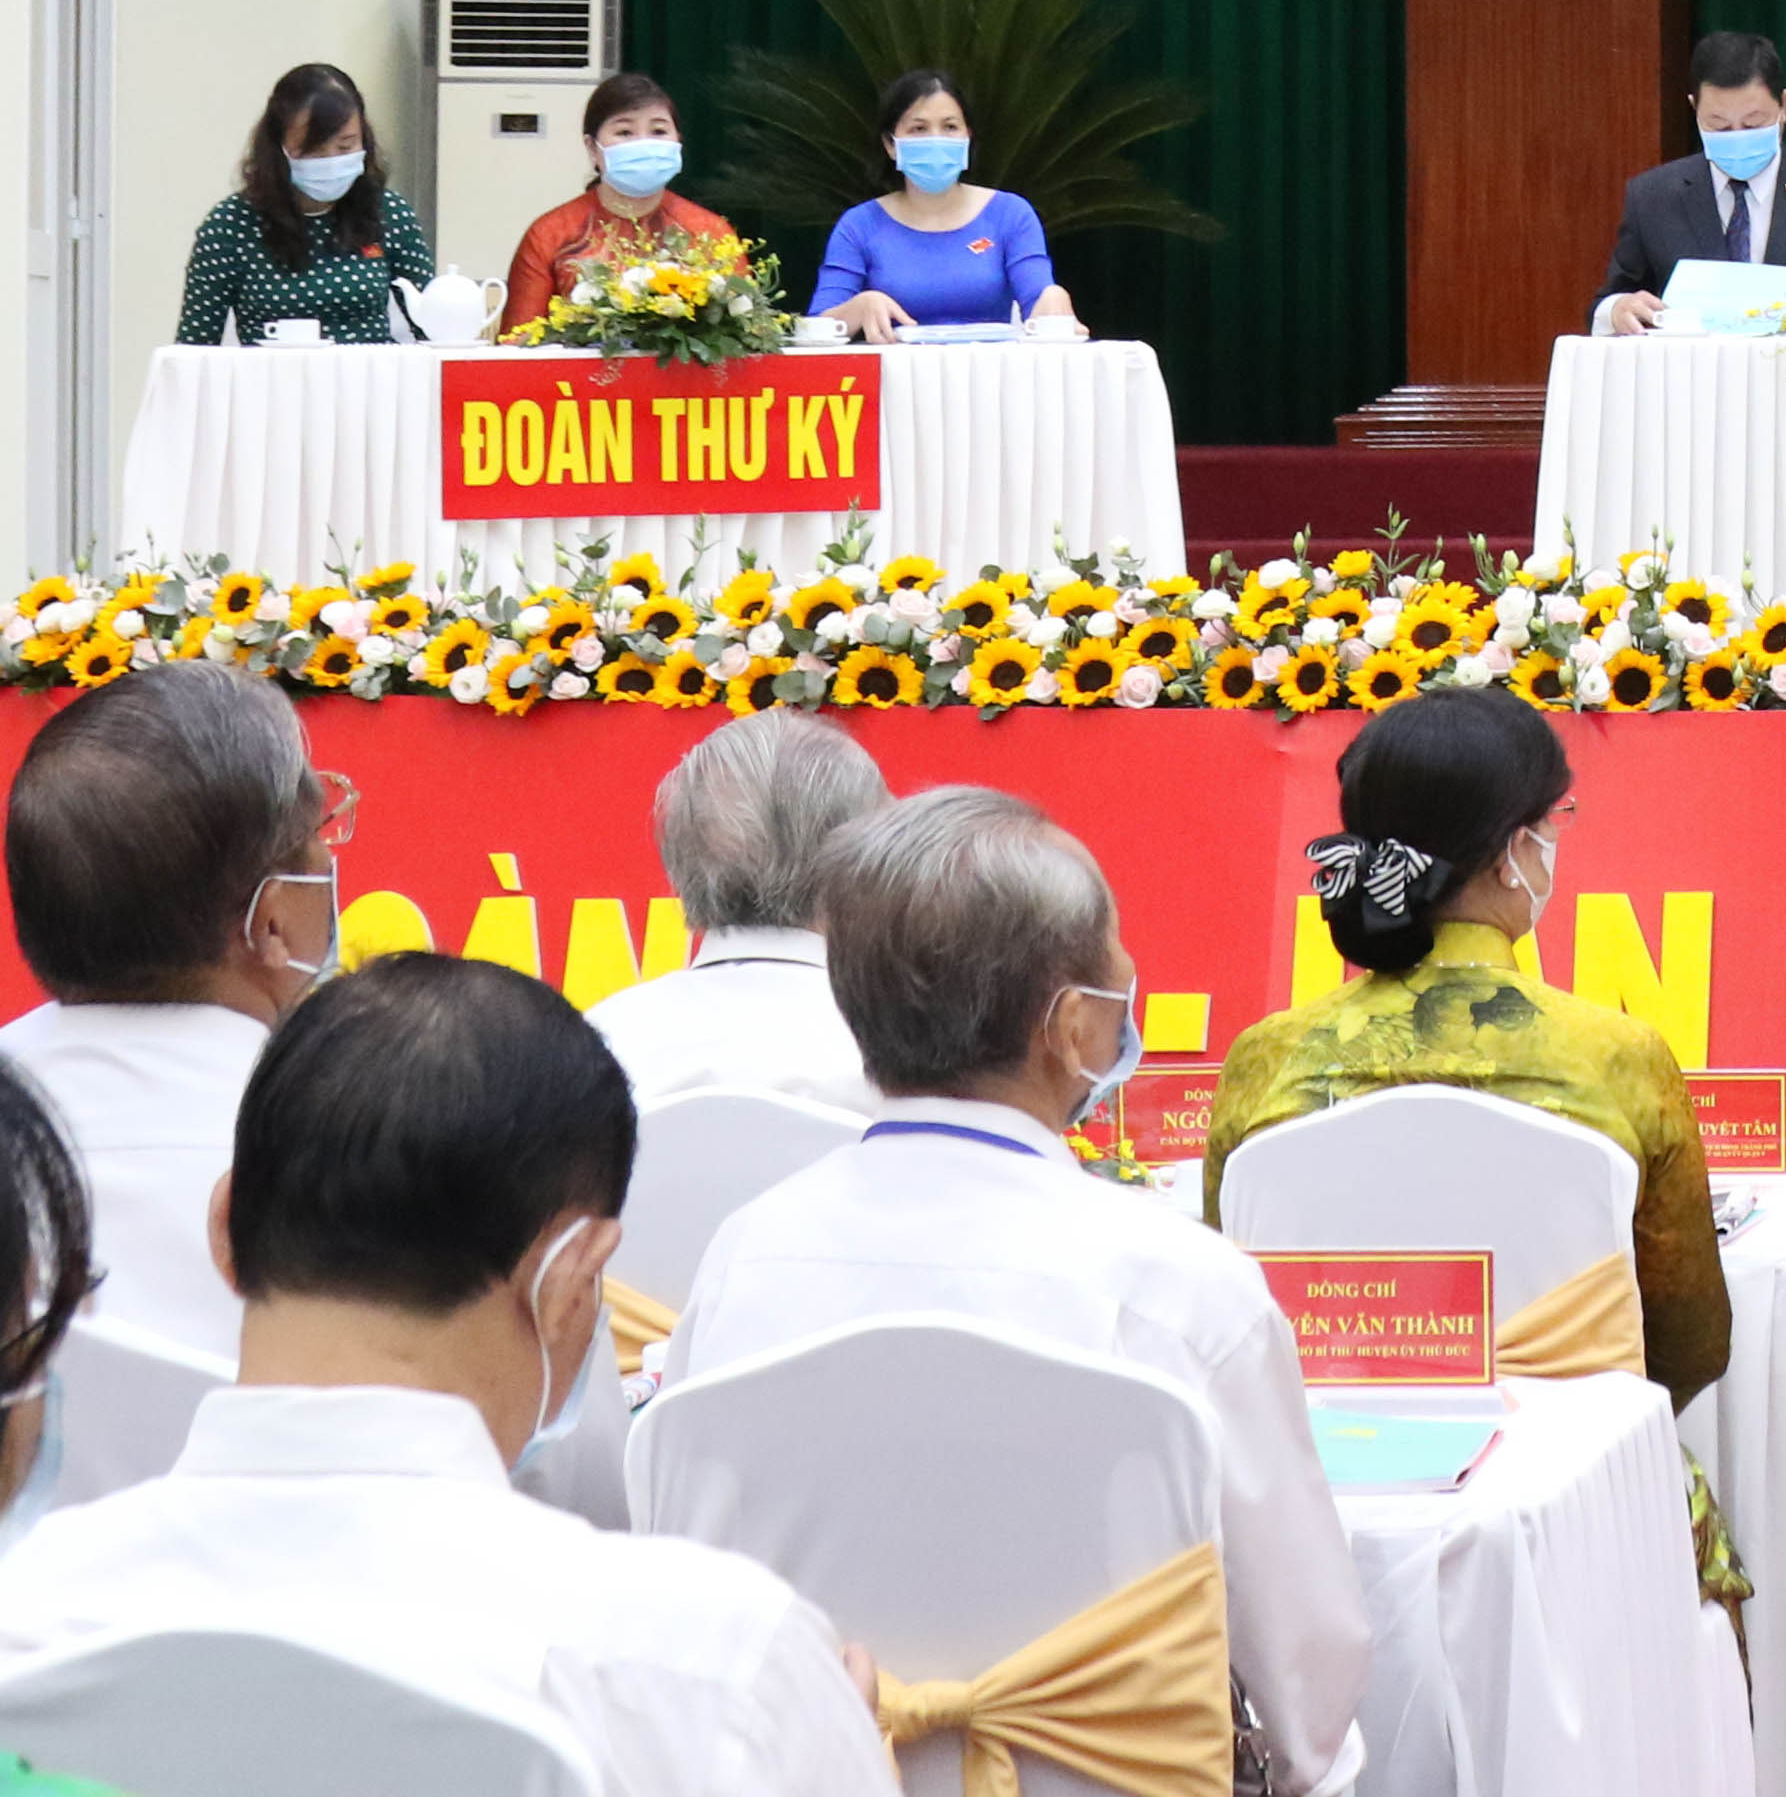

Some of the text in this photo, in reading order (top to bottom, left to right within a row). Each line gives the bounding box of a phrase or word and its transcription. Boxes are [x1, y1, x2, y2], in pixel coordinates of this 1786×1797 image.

[460, 376, 865, 487] ĐOÀN THƯ KÝ
[1307, 1278, 1397, 1299] ĐỒNG CHÍ
[1337, 1312, 1385, 1335] VĂN
[1391, 1311, 1476, 1335] THÀNH
